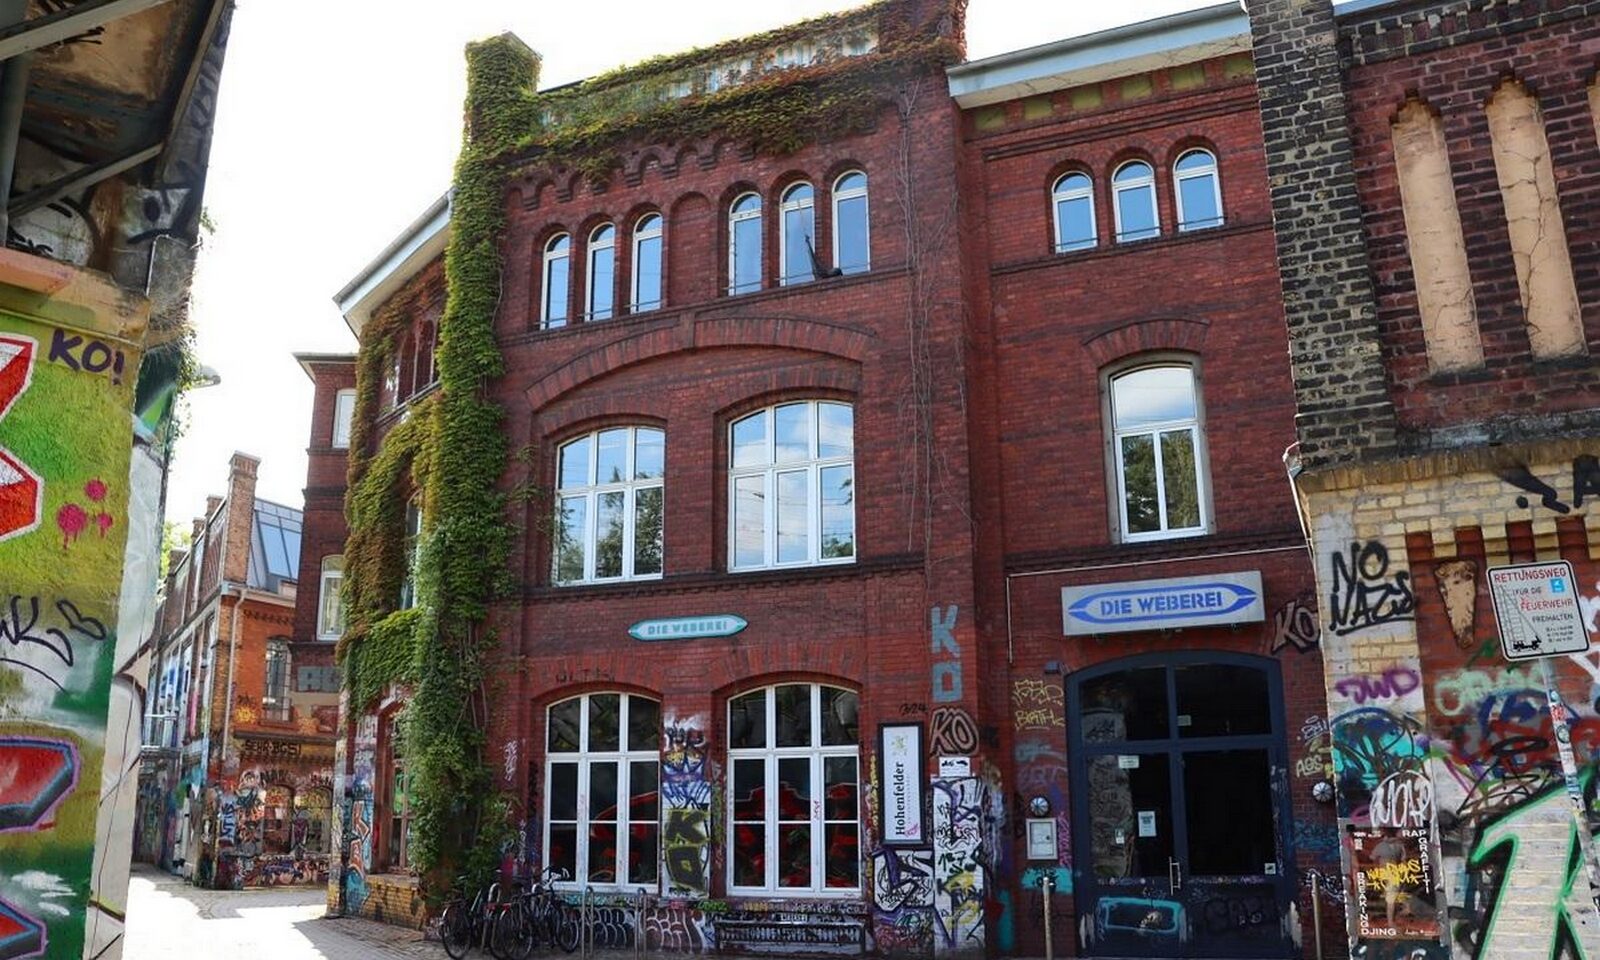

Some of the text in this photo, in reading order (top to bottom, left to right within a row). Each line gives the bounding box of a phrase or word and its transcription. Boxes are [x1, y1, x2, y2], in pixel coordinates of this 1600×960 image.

[48, 327, 126, 386] KO!
[1331, 540, 1389, 593] NO
[1494, 567, 1567, 583] RETTUNGSWEG
[1101, 591, 1222, 616] DIE WEBEREI
[1521, 598, 1573, 611] FEUERWEHR
[647, 620, 728, 635] DIE WEBEREI
[930, 706, 979, 758] KO
[893, 761, 906, 836] Hohenfelder
[1401, 829, 1427, 838] RAP
[1418, 837, 1431, 894] GRAFFITI
[1356, 871, 1370, 929] BREAKING
[1360, 927, 1398, 937] DJING
